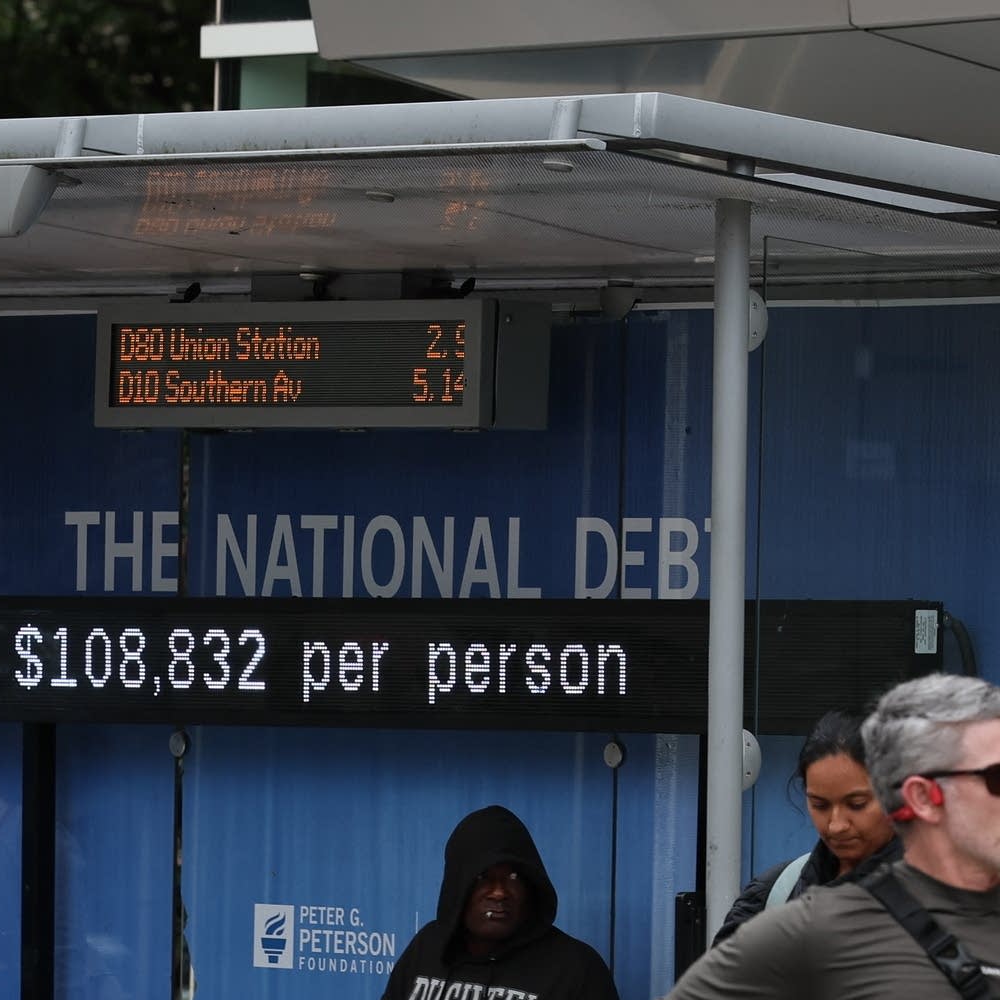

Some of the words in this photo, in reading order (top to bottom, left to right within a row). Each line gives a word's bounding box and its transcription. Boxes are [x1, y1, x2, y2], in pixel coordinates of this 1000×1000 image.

[120, 328, 164, 361] D80
[170, 328, 230, 361] Union
[236, 327, 320, 360] Station
[119, 370, 160, 403] D10
[165, 370, 267, 402] Southern
[273, 369, 302, 402] Av
[64, 510, 180, 592] THE
[216, 513, 542, 600] NATIONAL
[574, 516, 712, 600] DEB
[13, 623, 267, 697] $108,832
[302, 638, 390, 703] per
[427, 638, 630, 705] person
[299, 905, 345, 926] PETER
[350, 907, 364, 927] G.
[299, 928, 396, 957] PETERSON
[298, 956, 394, 975] FOUNDATION
